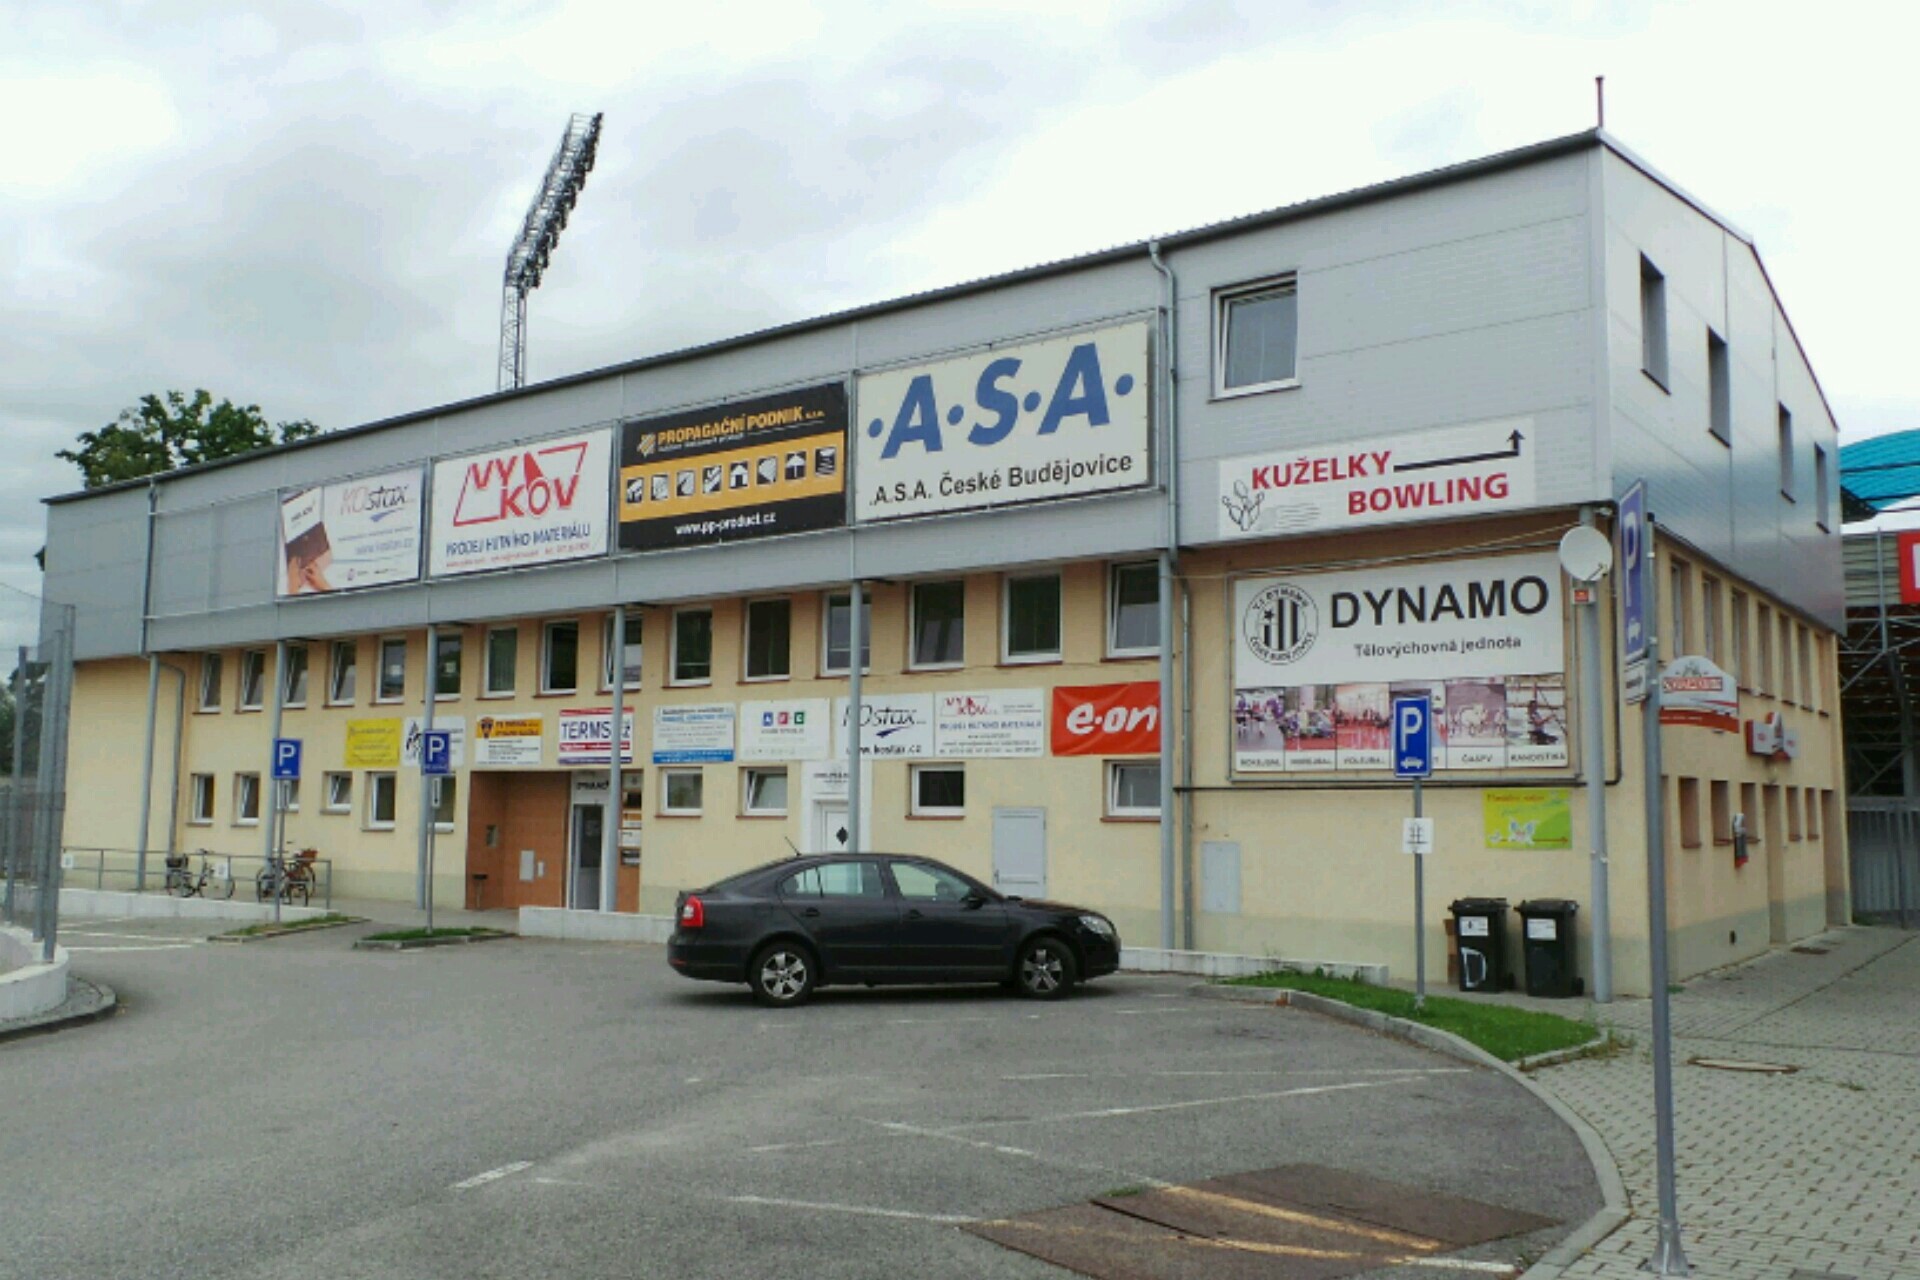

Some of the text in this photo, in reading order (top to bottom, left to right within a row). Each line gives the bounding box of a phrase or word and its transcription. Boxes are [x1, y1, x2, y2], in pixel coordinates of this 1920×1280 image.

[658, 413, 746, 445] PROPAGAČNÍ
[747, 406, 804, 430] PODNIK
[939, 469, 1002, 498] České
[1008, 453, 1132, 487] Budějovice
[1251, 450, 1391, 490] KUŽELKY
[1347, 472, 1509, 516] BOWLING
[446, 540, 482, 557] PRODEJ
[486, 529, 530, 551] HUTNÍHO
[533, 522, 591, 545] MATERIÁLU
[675, 512, 777, 535] www.pp-product.cz
[1624, 511, 1638, 608] P
[1331, 575, 1549, 628] DYNAMO
[1353, 635, 1521, 658] Tělovýchovná jednota
[429, 735, 444, 762] P
[1402, 707, 1422, 752] P
[279, 743, 295, 766] P
